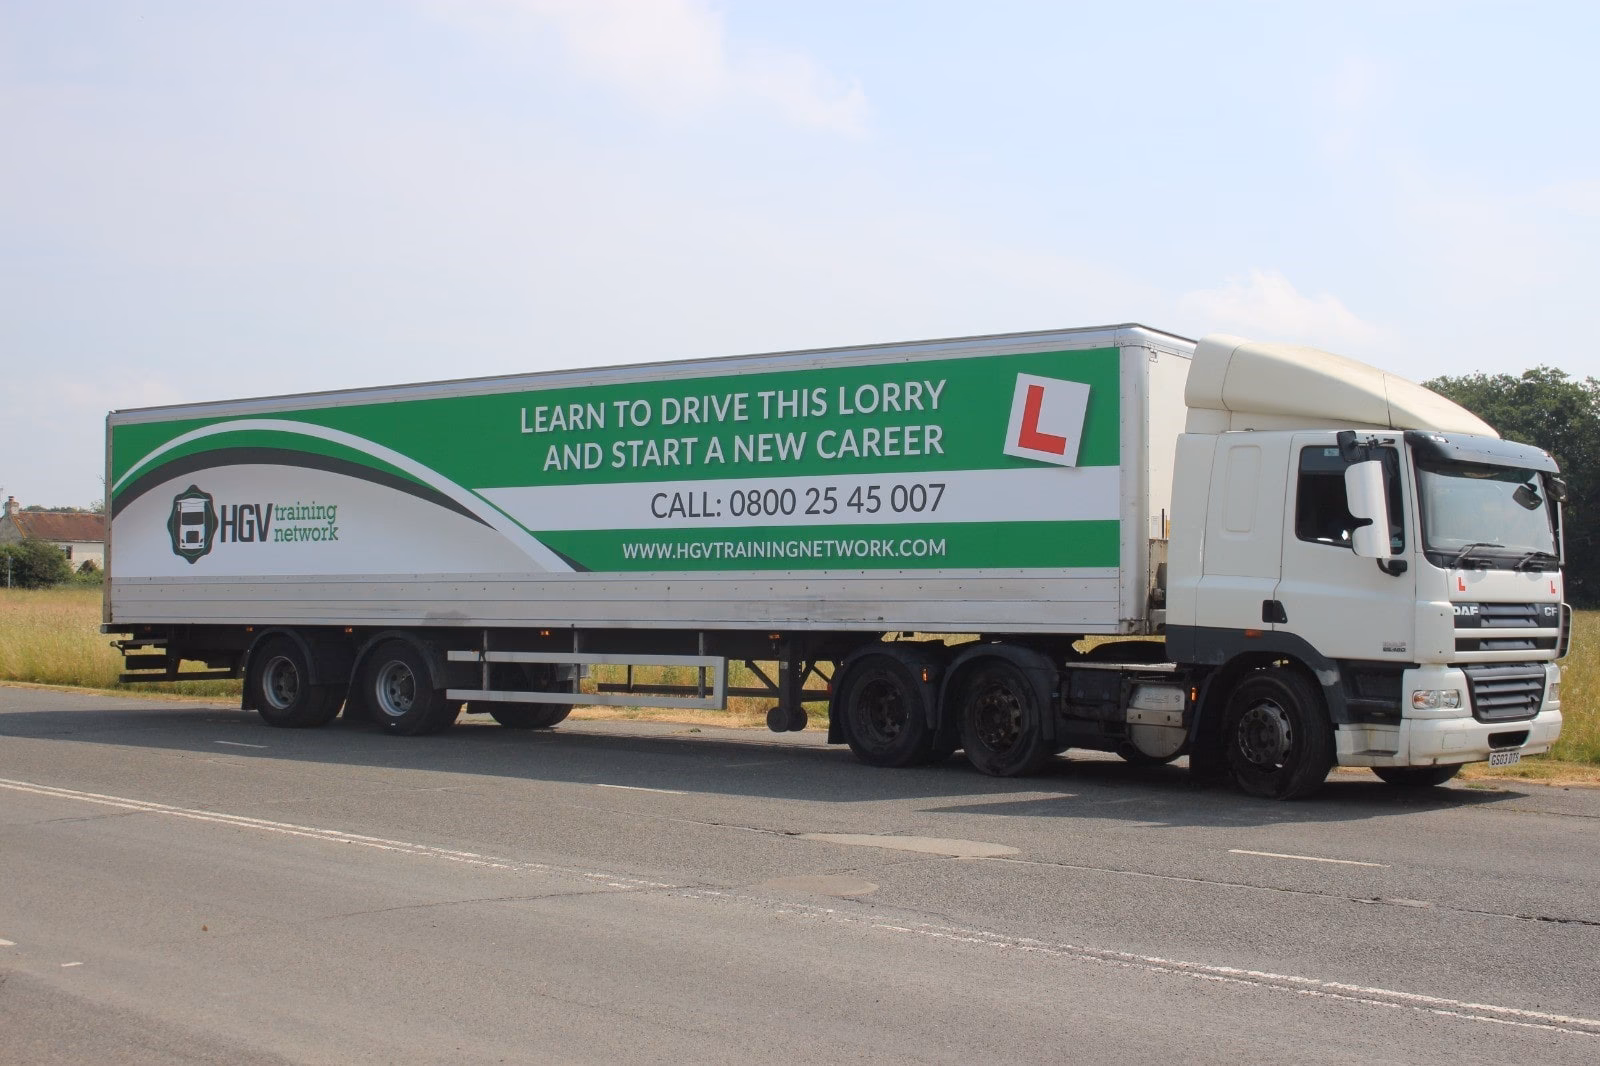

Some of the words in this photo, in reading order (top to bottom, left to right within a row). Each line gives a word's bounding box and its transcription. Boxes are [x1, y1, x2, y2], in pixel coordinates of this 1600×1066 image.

[521, 402, 605, 433] LEARN
[613, 400, 652, 428] TO
[661, 393, 749, 425] DRIVE
[757, 387, 828, 420] THIS
[839, 379, 947, 415] LORRY
[1018, 384, 1067, 456] L
[543, 442, 603, 471] AND
[611, 437, 699, 468] START
[704, 436, 725, 464] A
[734, 431, 807, 463] NEW
[816, 424, 945, 459] CAREER
[650, 491, 722, 519] CALL:
[729, 488, 797, 517] 0800
[804, 486, 838, 515] 25
[846, 485, 882, 514] 45
[890, 483, 946, 513] 007
[220, 503, 273, 543] HGV
[274, 501, 338, 524] training
[274, 524, 339, 542] network
[622, 538, 946, 559] WWW.HGVTRAININGNETWORK.COM
[1453, 605, 1479, 616] DAF
[1544, 606, 1558, 617] CF
